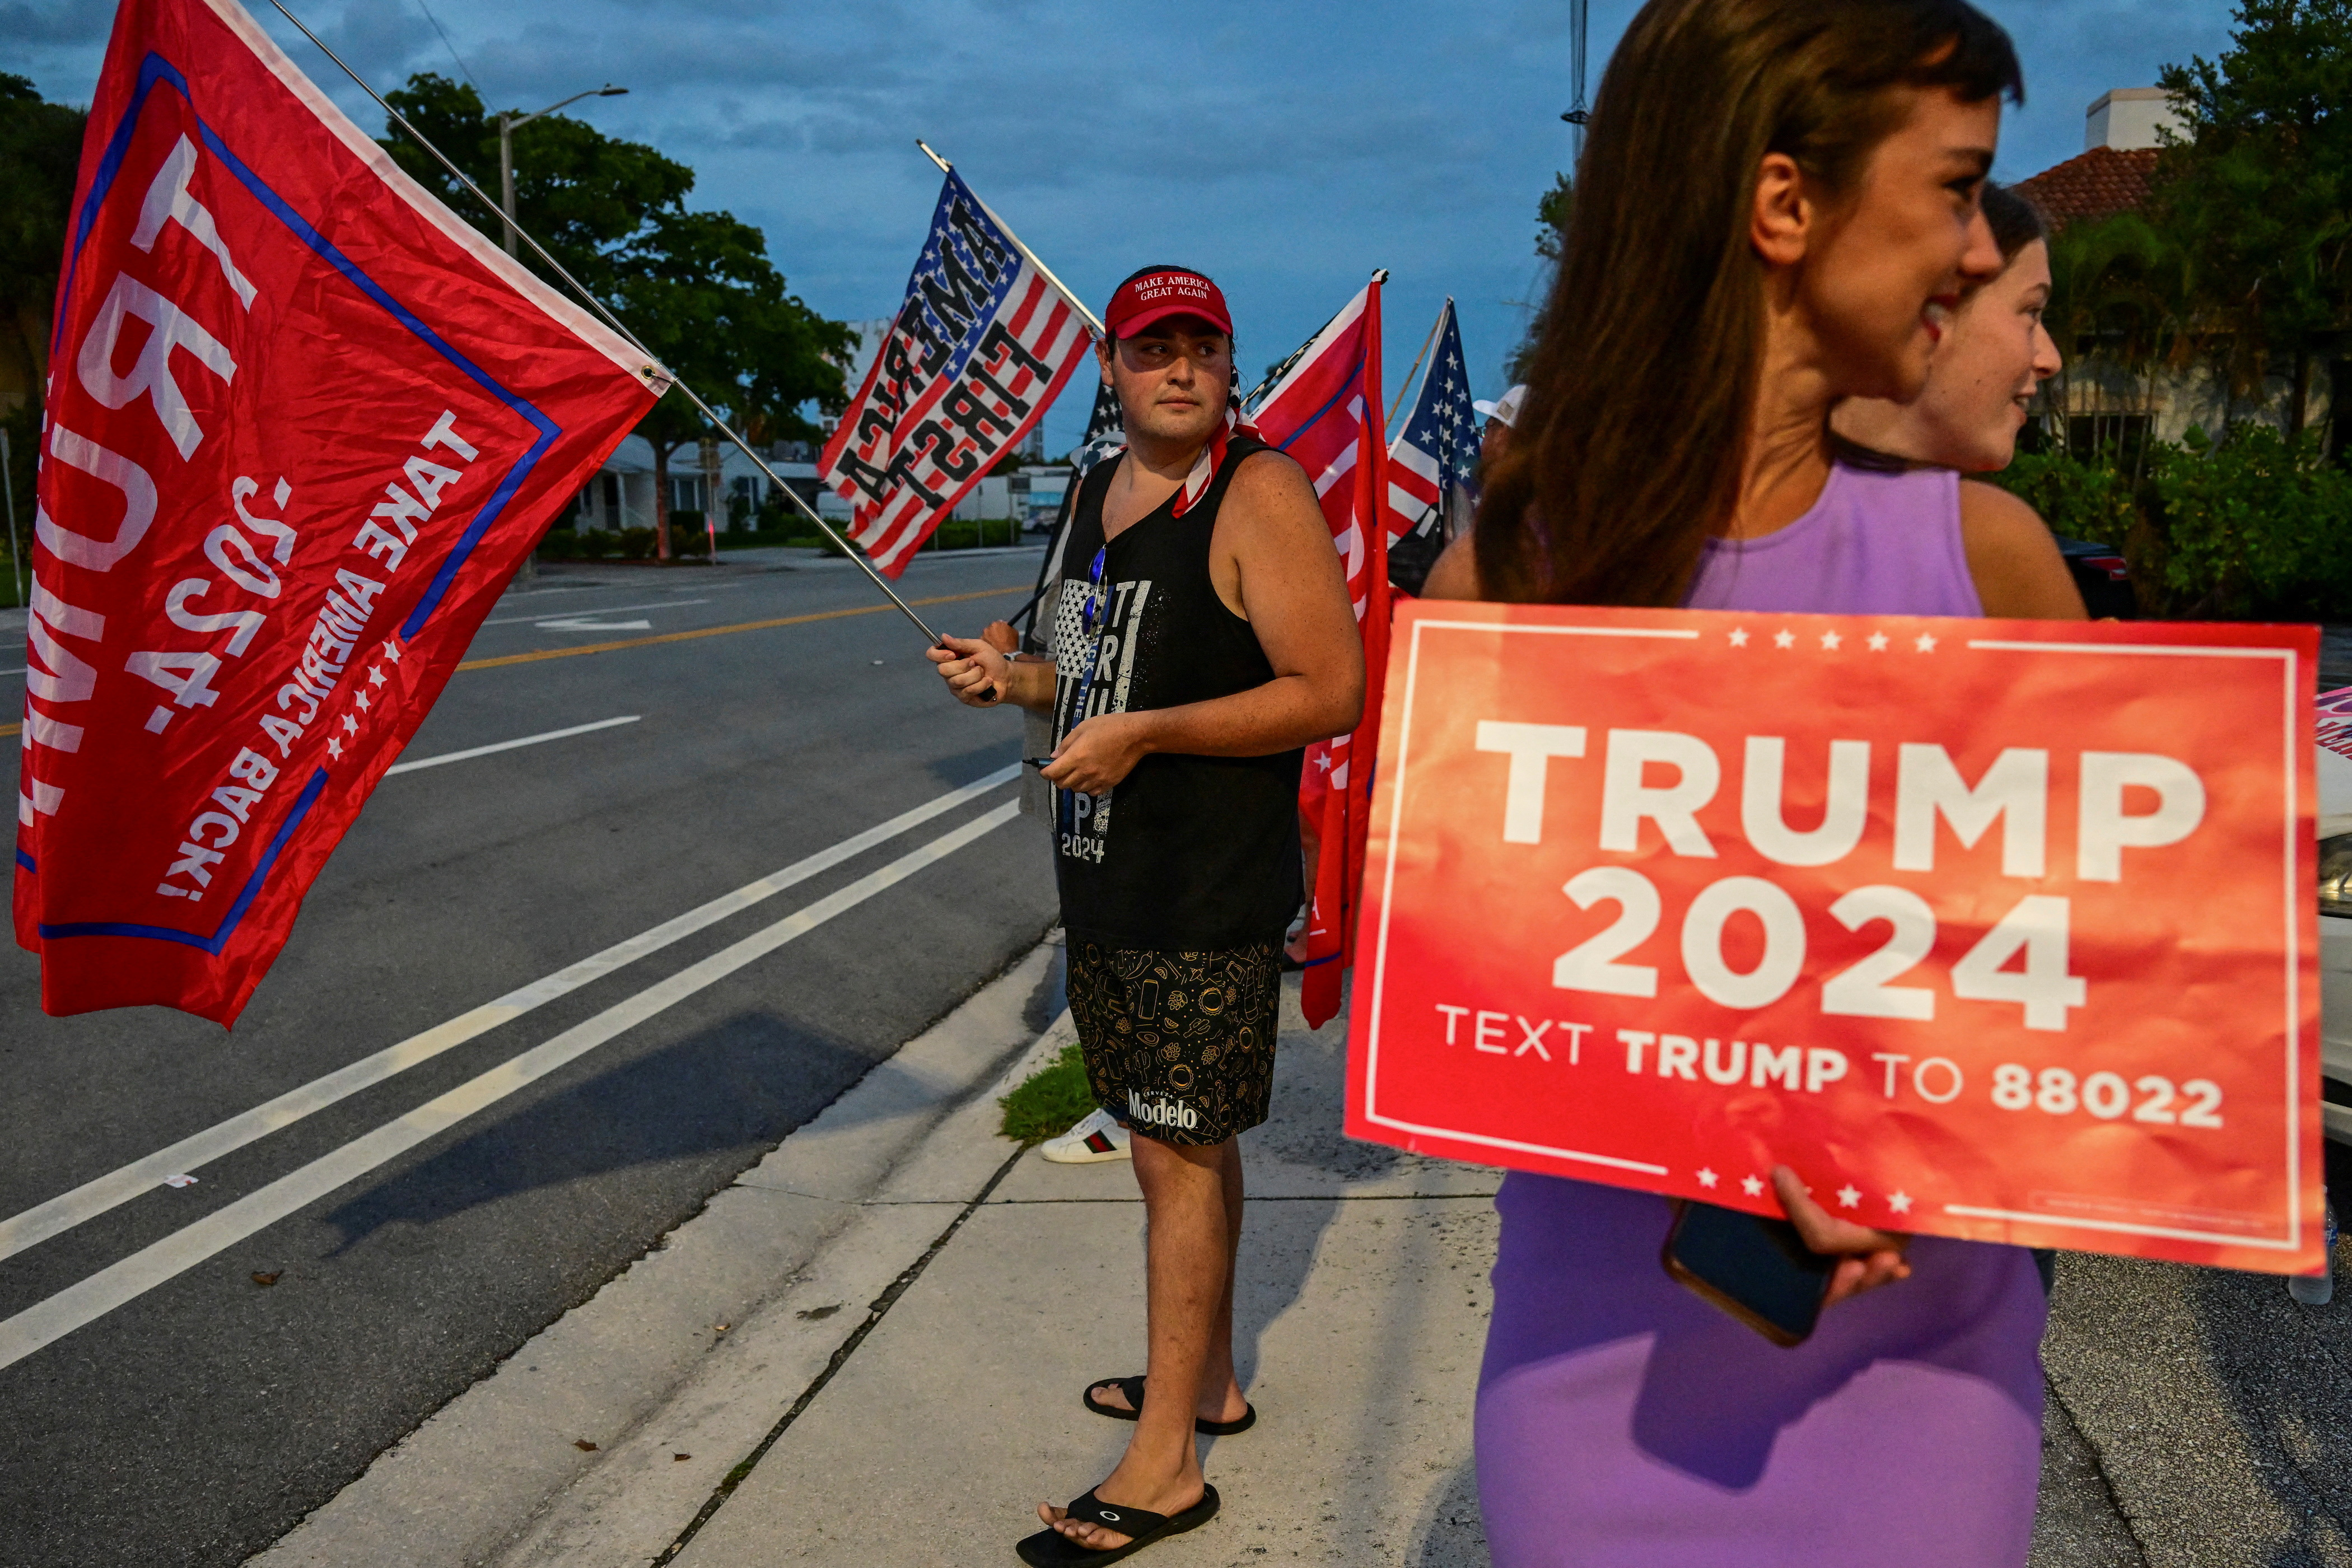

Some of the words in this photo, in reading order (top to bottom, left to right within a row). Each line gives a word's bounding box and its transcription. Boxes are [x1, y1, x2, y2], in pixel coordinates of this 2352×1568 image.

[1135, 277, 1164, 292] MAKE
[1168, 276, 1211, 292] AMERICA
[1140, 287, 1173, 301] GREAT
[1177, 287, 1207, 300] AGAIN
[1073, 683, 1090, 719] THE
[1474, 720, 2206, 883] TRUMP
[1062, 833, 1105, 864] 2024
[1551, 865, 2087, 1032] 2024
[1435, 1003, 1594, 1066] TEXT
[1616, 1029, 1848, 1094] TRUMP
[1872, 1052, 1964, 1104] TO
[1991, 1063, 2224, 1128] 88022
[1128, 1087, 1197, 1130] Modelo
[1143, 1090, 1174, 1099] CERVEZA
